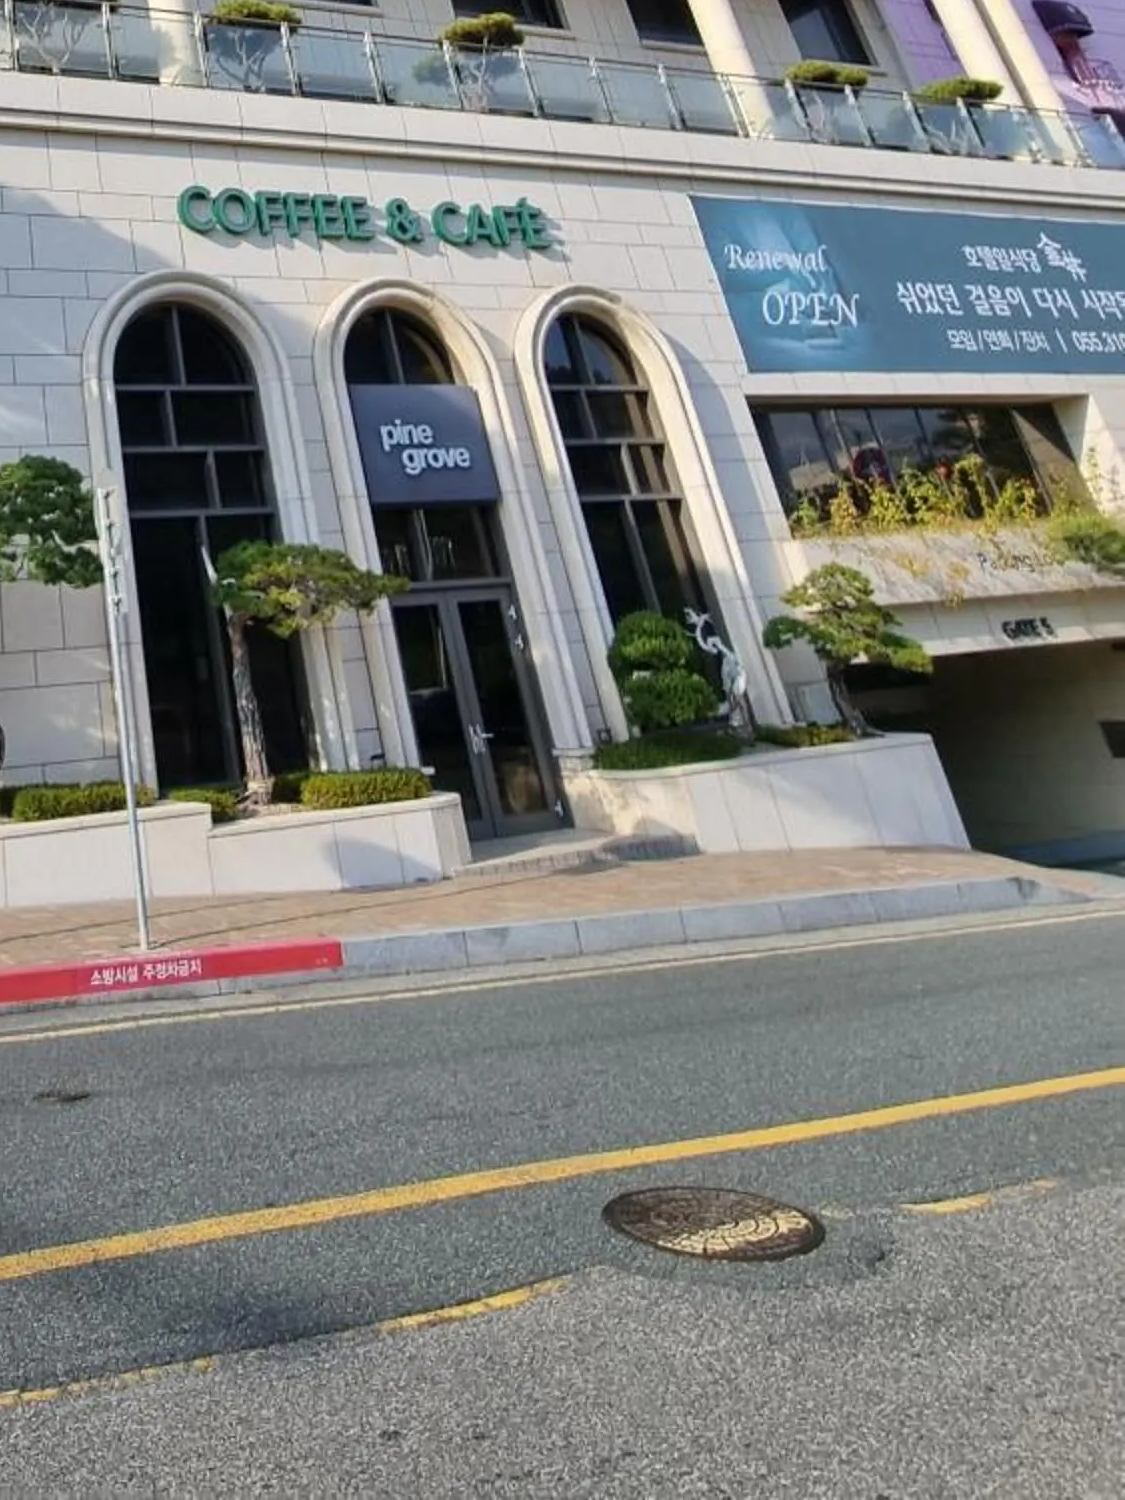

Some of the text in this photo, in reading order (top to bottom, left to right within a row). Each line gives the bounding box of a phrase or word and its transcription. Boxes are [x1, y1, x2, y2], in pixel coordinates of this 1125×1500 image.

[177, 185, 551, 250] COFFEE & CAFÉ
[723, 243, 828, 284] Renewal
[762, 292, 860, 328] OPEN
[896, 280, 964, 316] 쉬었던
[963, 284, 1032, 318] 걸음이
[1031, 287, 1080, 320] 다시
[379, 419, 434, 453] pine
[401, 445, 472, 476] grove
[1001, 618, 1041, 640] GATE
[90, 958, 203, 985] 소방시설 주정차금지
